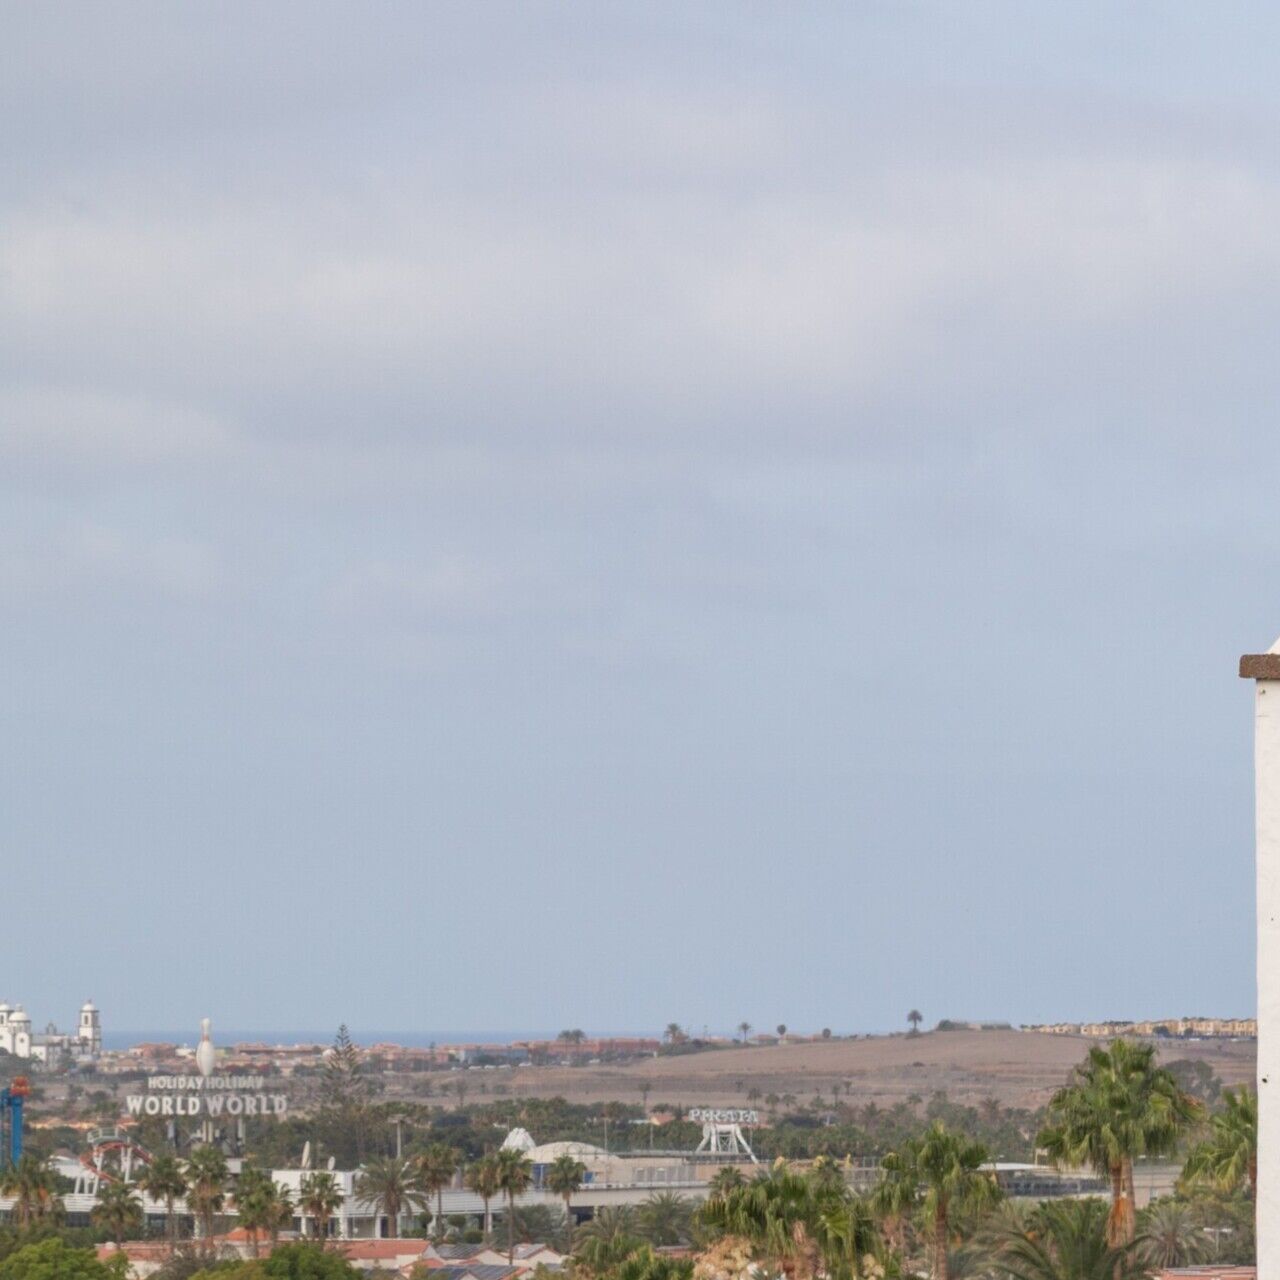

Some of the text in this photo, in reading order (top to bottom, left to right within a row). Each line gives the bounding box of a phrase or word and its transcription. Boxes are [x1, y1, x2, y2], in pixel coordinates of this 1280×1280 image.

[149, 1075, 202, 1089] HOLIDAY
[126, 1095, 200, 1116] WORLD
[206, 1095, 288, 1117] WORLD
